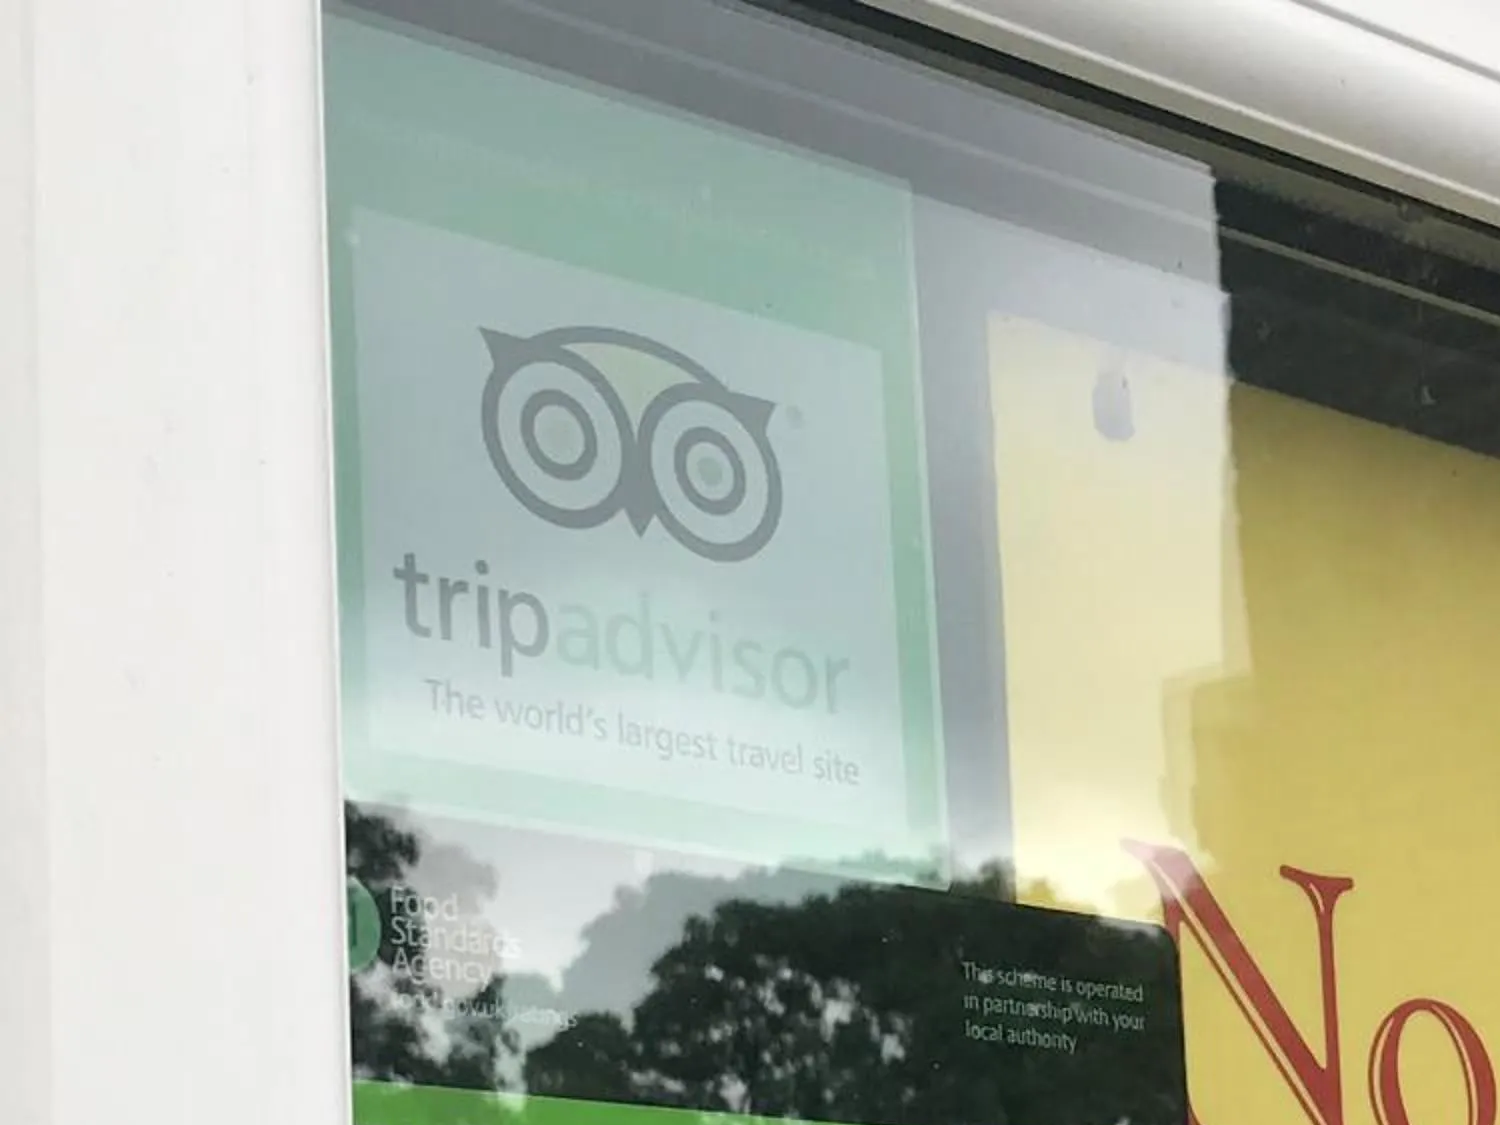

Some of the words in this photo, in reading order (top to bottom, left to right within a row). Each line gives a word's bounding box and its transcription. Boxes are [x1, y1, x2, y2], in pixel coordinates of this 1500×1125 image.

[392, 552, 850, 715] tripadvisor
[424, 678, 486, 720] The
[494, 699, 608, 742] world's
[617, 712, 718, 761] largest
[726, 735, 803, 774] travel
[813, 751, 861, 787] site
[390, 885, 459, 922] Food
[390, 946, 495, 993] Agency
[962, 961, 995, 985] This
[998, 968, 1057, 992] scheme
[1061, 976, 1073, 993] is
[1076, 981, 1144, 1003] operated
[963, 994, 980, 1010] in
[983, 997, 1072, 1024] partnership
[1076, 1003, 1110, 1027] with
[1111, 1013, 1145, 1034] your
[965, 1020, 1004, 1041] local
[1007, 1026, 1078, 1055] authority
